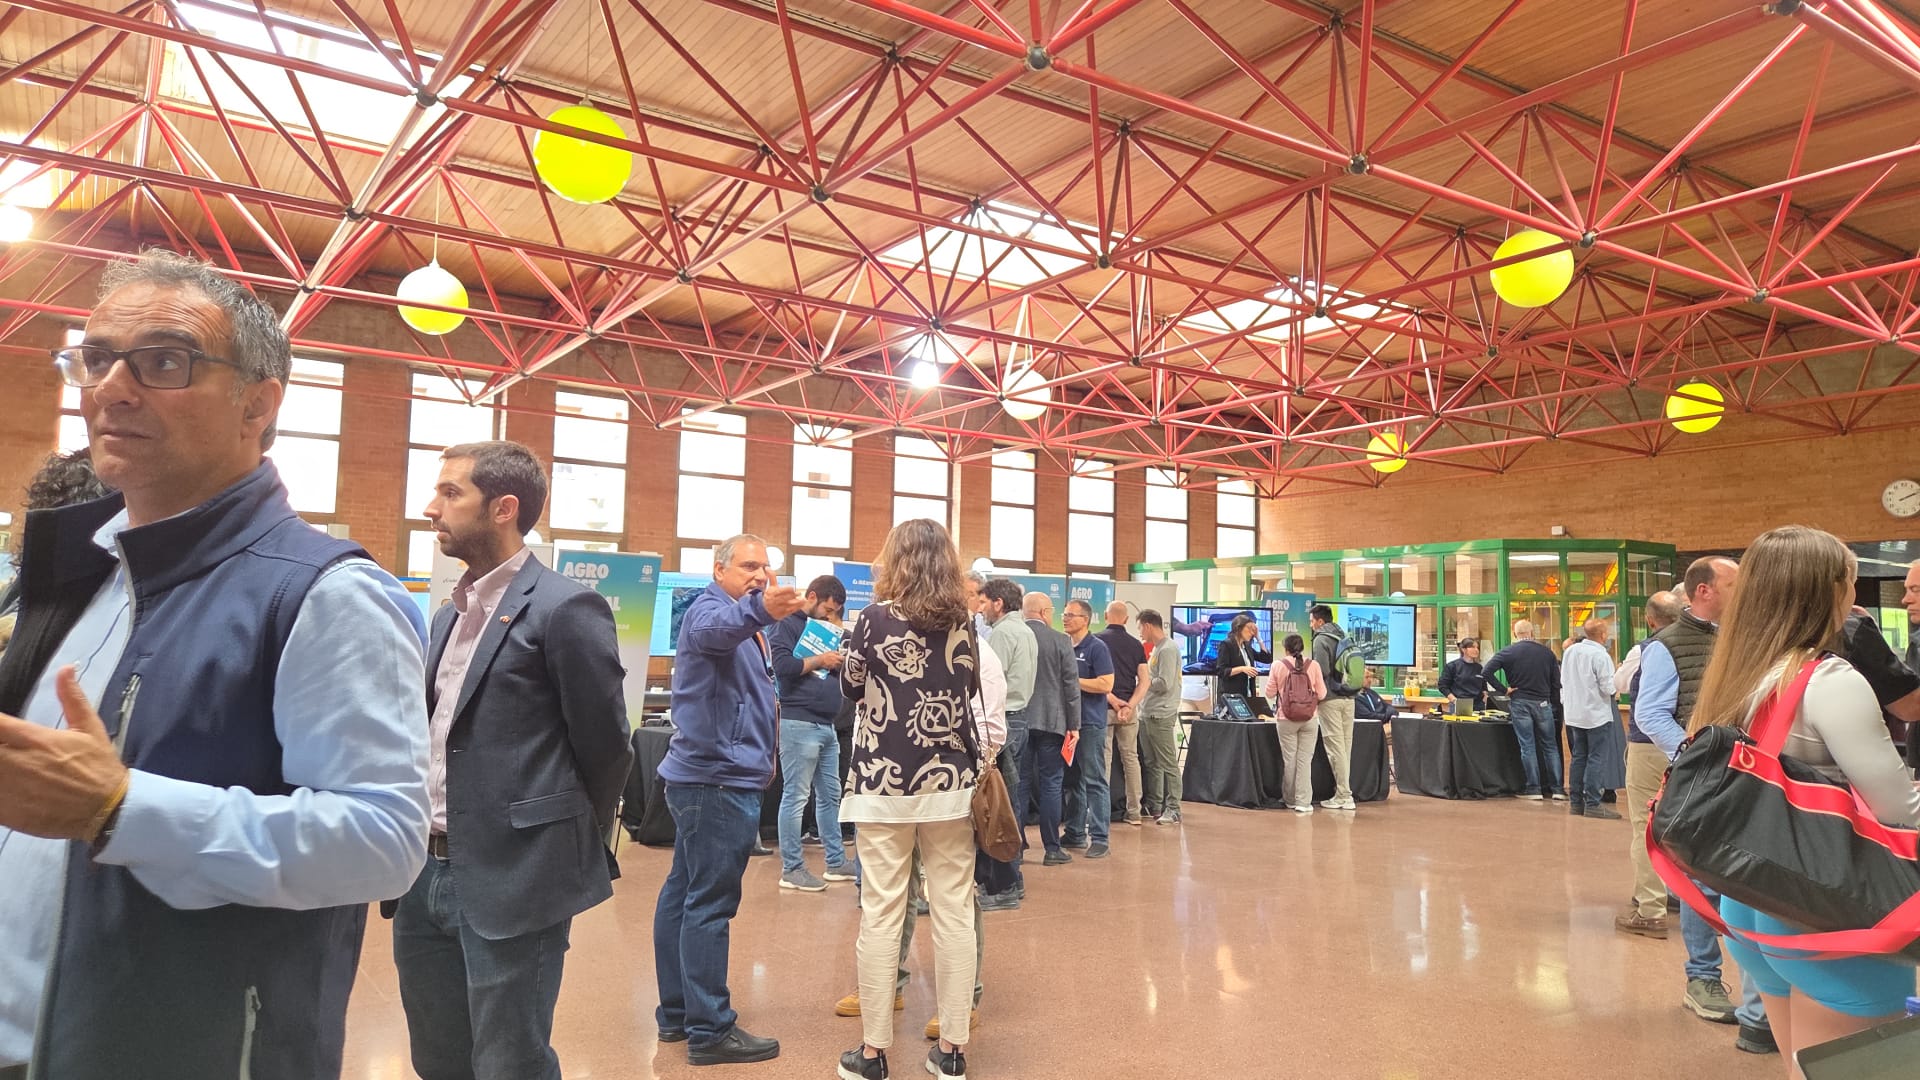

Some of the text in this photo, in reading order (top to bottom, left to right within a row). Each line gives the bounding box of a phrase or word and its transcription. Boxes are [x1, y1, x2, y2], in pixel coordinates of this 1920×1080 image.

[562, 561, 609, 579] AGRO
[1071, 586, 1092, 600] AGRO
[1265, 599, 1290, 610] AGRO
[1273, 621, 1298, 632] IGITAL
